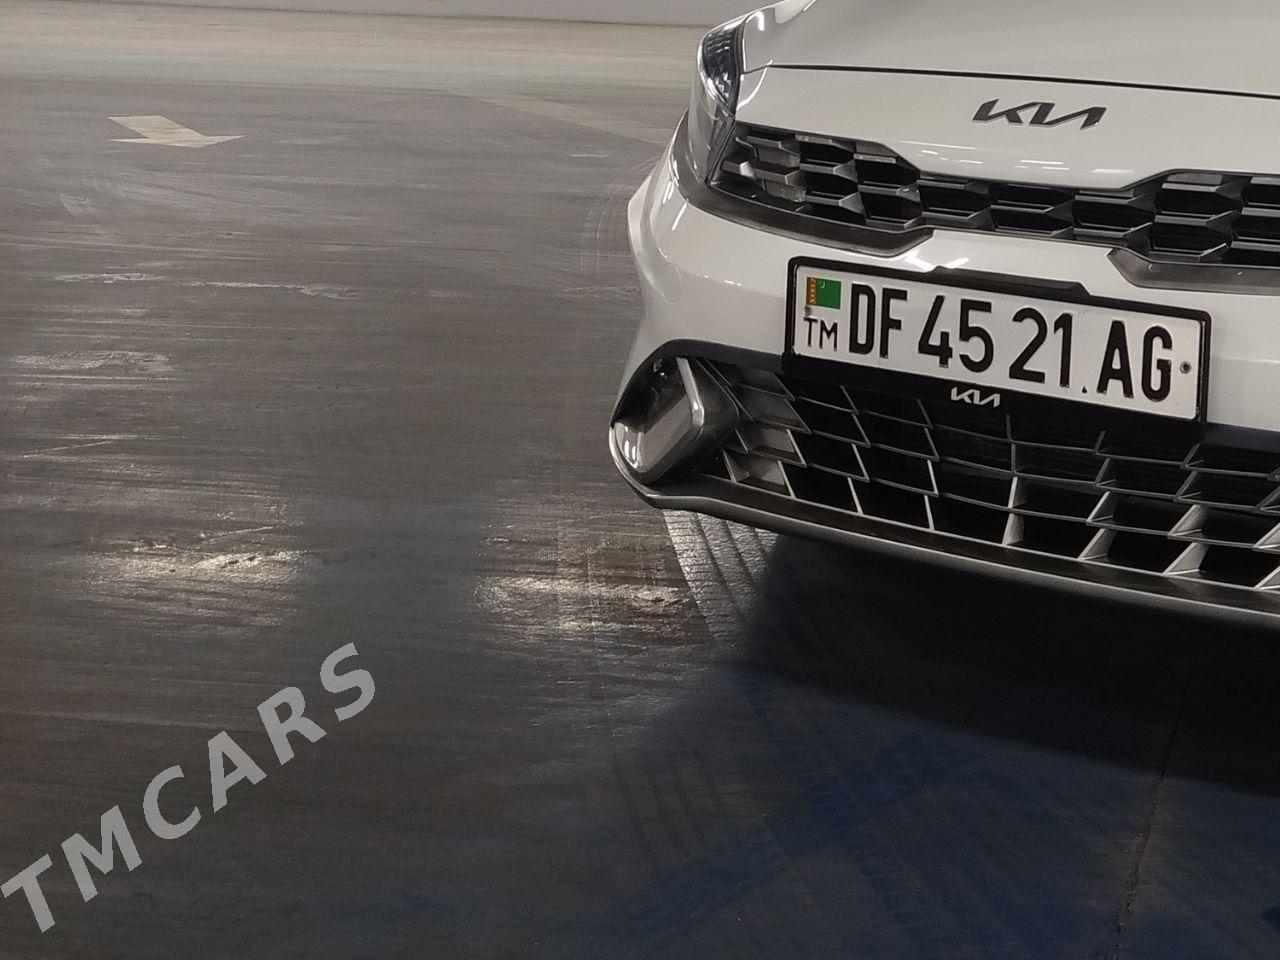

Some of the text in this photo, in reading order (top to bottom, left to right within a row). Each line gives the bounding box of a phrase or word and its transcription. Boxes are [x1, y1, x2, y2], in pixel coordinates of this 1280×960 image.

[972, 98, 1107, 130] KIA
[803, 316, 838, 352] TM
[849, 283, 908, 358] DF
[917, 295, 995, 373] 45
[1096, 319, 1173, 401] AG
[951, 387, 1001, 408] KIA
